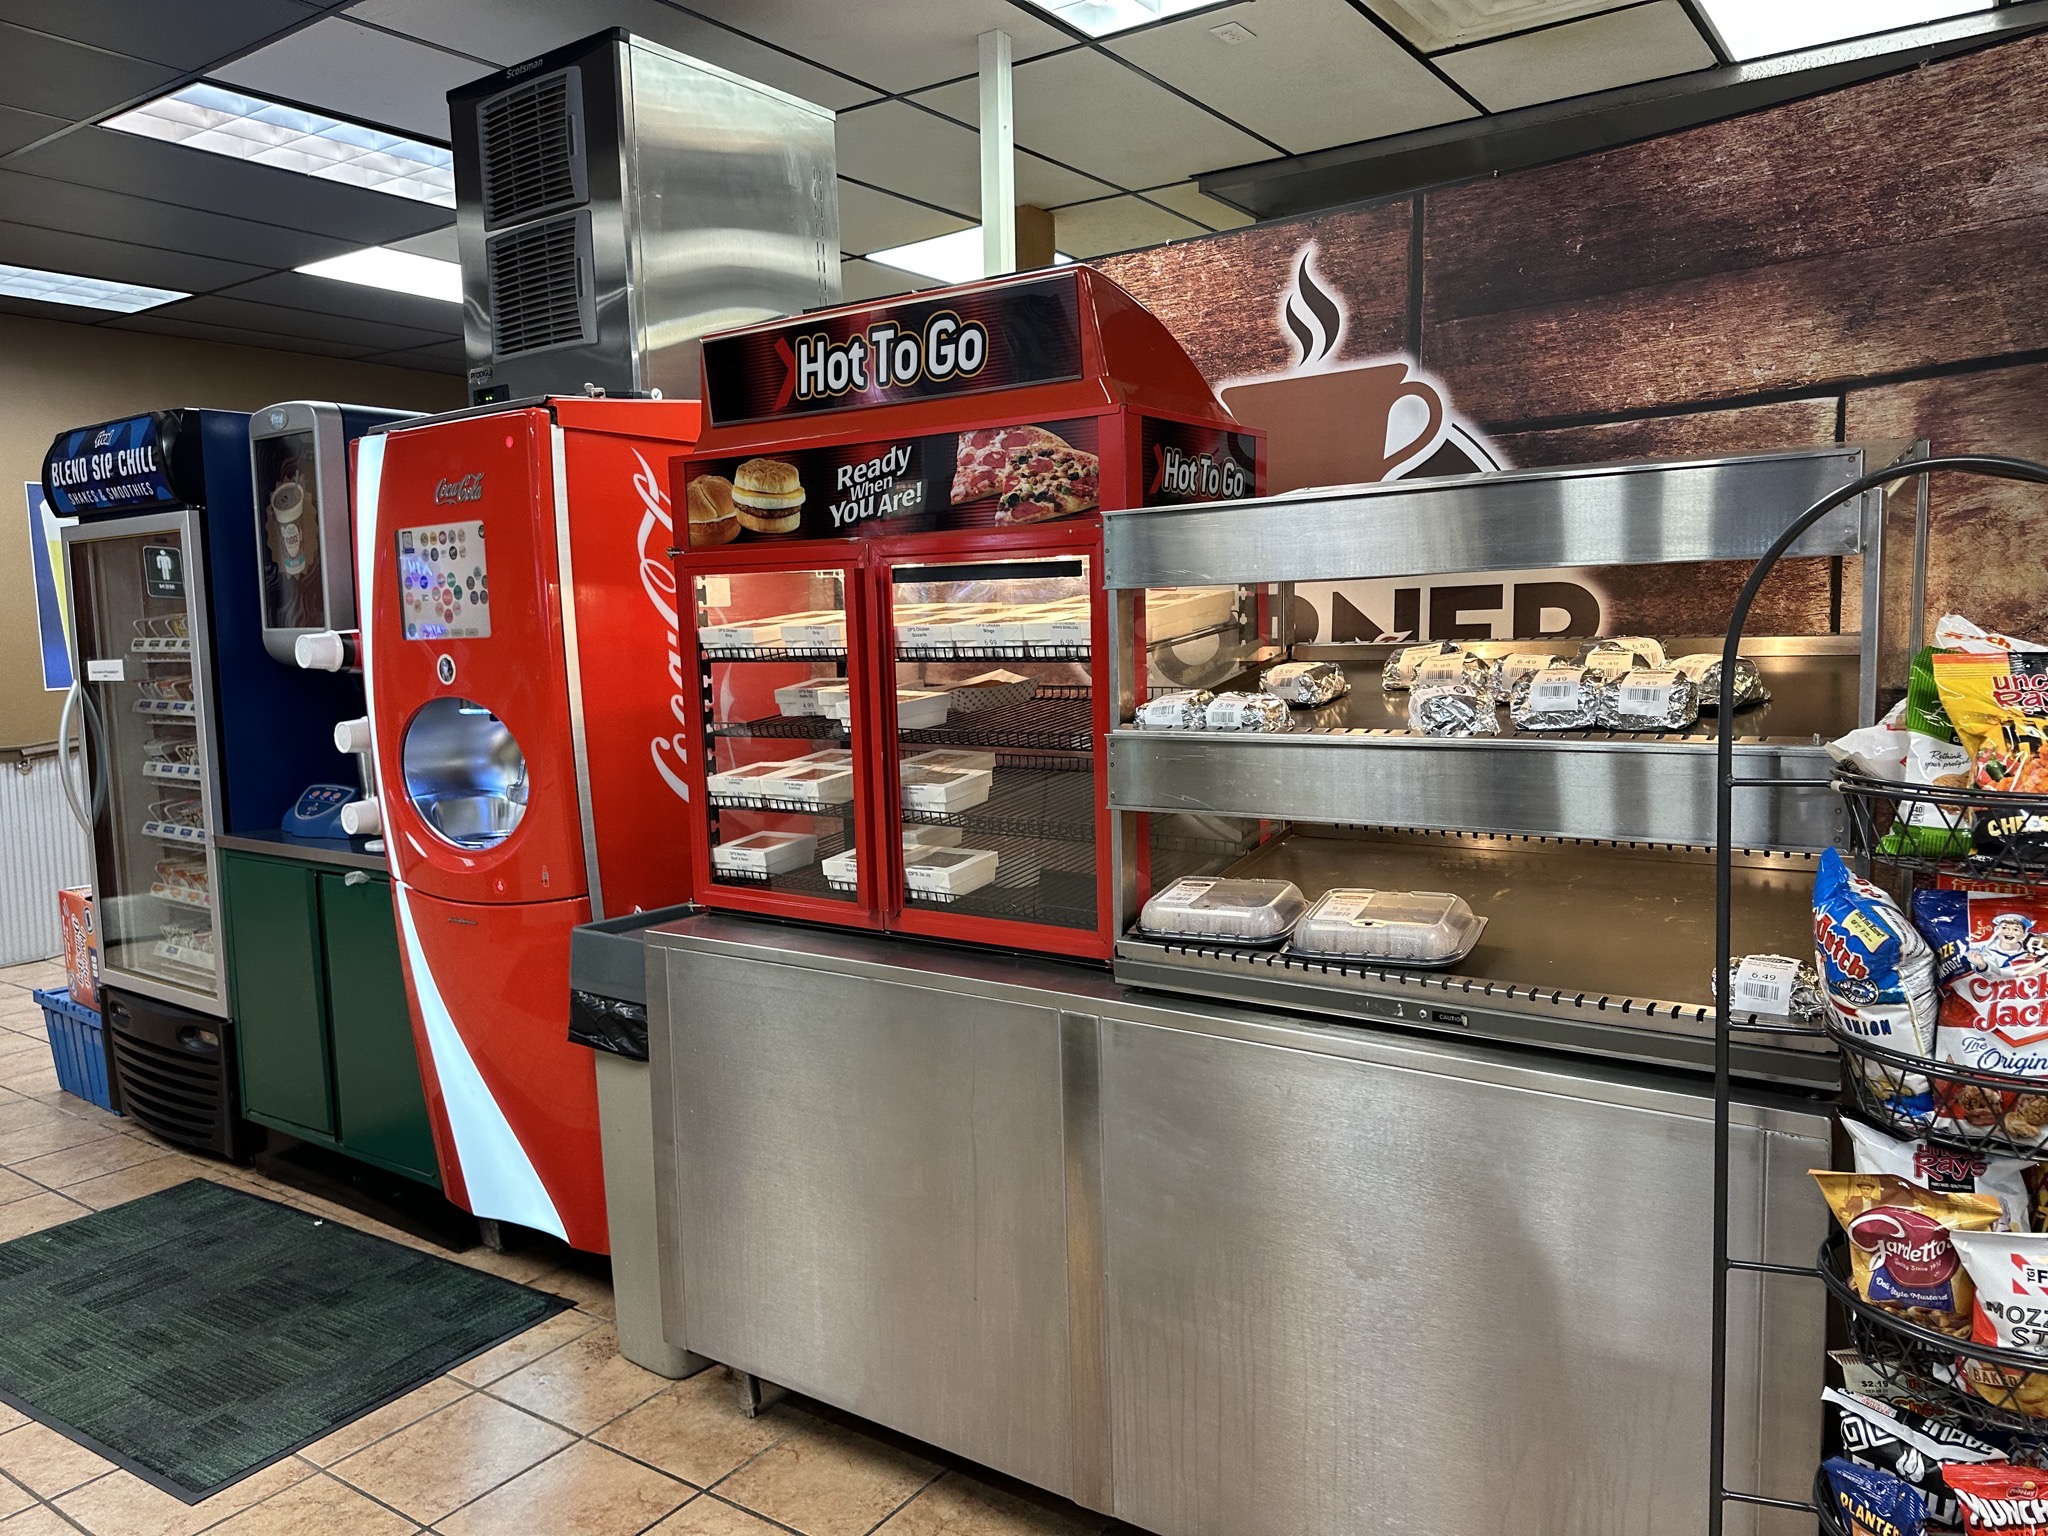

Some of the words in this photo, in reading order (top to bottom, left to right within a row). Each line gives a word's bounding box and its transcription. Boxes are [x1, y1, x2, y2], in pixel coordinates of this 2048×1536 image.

[506, 58, 543, 79] Scotsman
[799, 340, 866, 394] Hot
[872, 329, 918, 383] To
[928, 319, 983, 376] Go
[51, 457, 88, 488] BLEND
[91, 452, 113, 481] SIP
[117, 445, 157, 477] CHILL
[837, 445, 912, 491] Ready
[1164, 452, 1198, 492] Hot
[1200, 458, 1220, 494] To
[1222, 462, 1244, 497] Go
[67, 489, 99, 506] SHAKES
[99, 488, 107, 502] &
[105, 481, 154, 501] SMOOTHIES
[850, 475, 893, 502] When
[829, 495, 875, 528] You
[877, 481, 922, 517] Are!
[1060, 638, 1074, 646] 6.99
[1631, 642, 1650, 650] 6.49
[1929, 750, 1963, 760] Rethink
[1923, 761, 1941, 770] your
[1912, 806, 1924, 814] 40
[1816, 913, 1869, 980] Dutch
[1751, 971, 1777, 981] 6.49
[1844, 1016, 1892, 1036] ONION
[1962, 1036, 1989, 1054] The
[2026, 1268, 2037, 1283] TGI
[1909, 1292, 1949, 1301] Mustard
[1861, 1380, 1889, 1388] $2.19
[1973, 1367, 2018, 1387] BAKED
